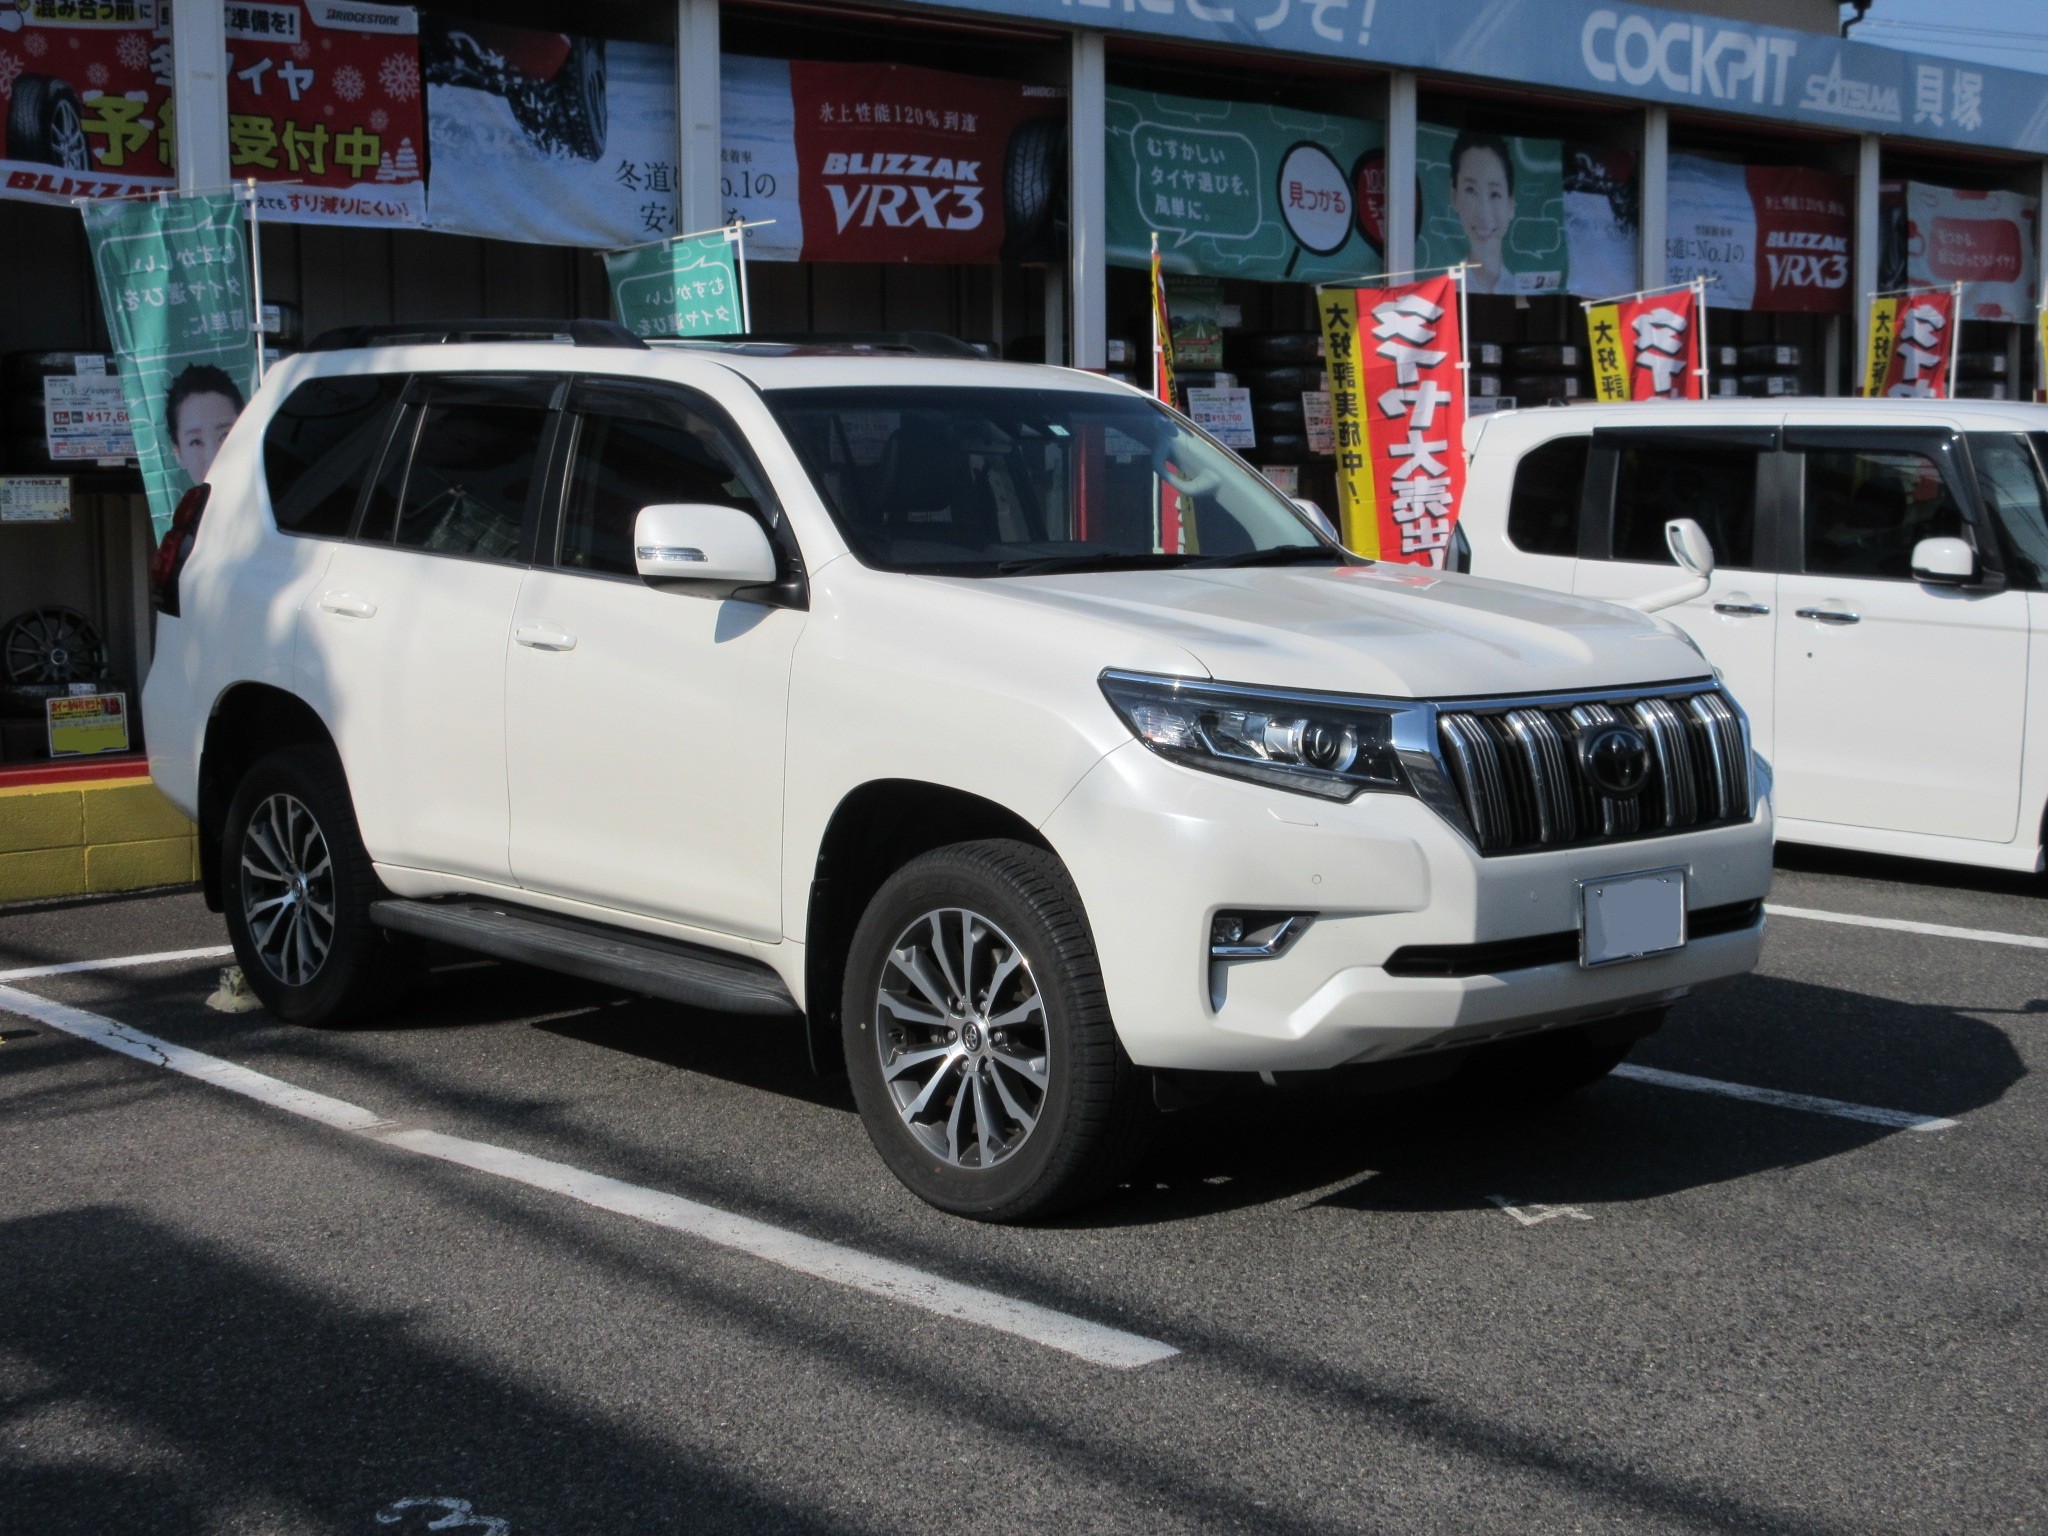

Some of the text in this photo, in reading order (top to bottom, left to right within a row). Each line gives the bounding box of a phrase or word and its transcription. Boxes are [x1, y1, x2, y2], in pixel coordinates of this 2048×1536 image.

[225, 8, 296, 35] 準備を!
[326, 9, 400, 26] BRIDGESTONE
[226, 52, 315, 101] イヤ
[1581, 9, 1797, 106] COCKPIT
[1914, 65, 1984, 131] 貝塚
[229, 114, 381, 178] 受付中
[822, 152, 981, 182] BLIZZAK
[823, 184, 985, 236] VRX3
[1288, 180, 1346, 214] 見つかる
[1766, 231, 1848, 252] BLIZZAK
[1766, 253, 1848, 291] VRX3
